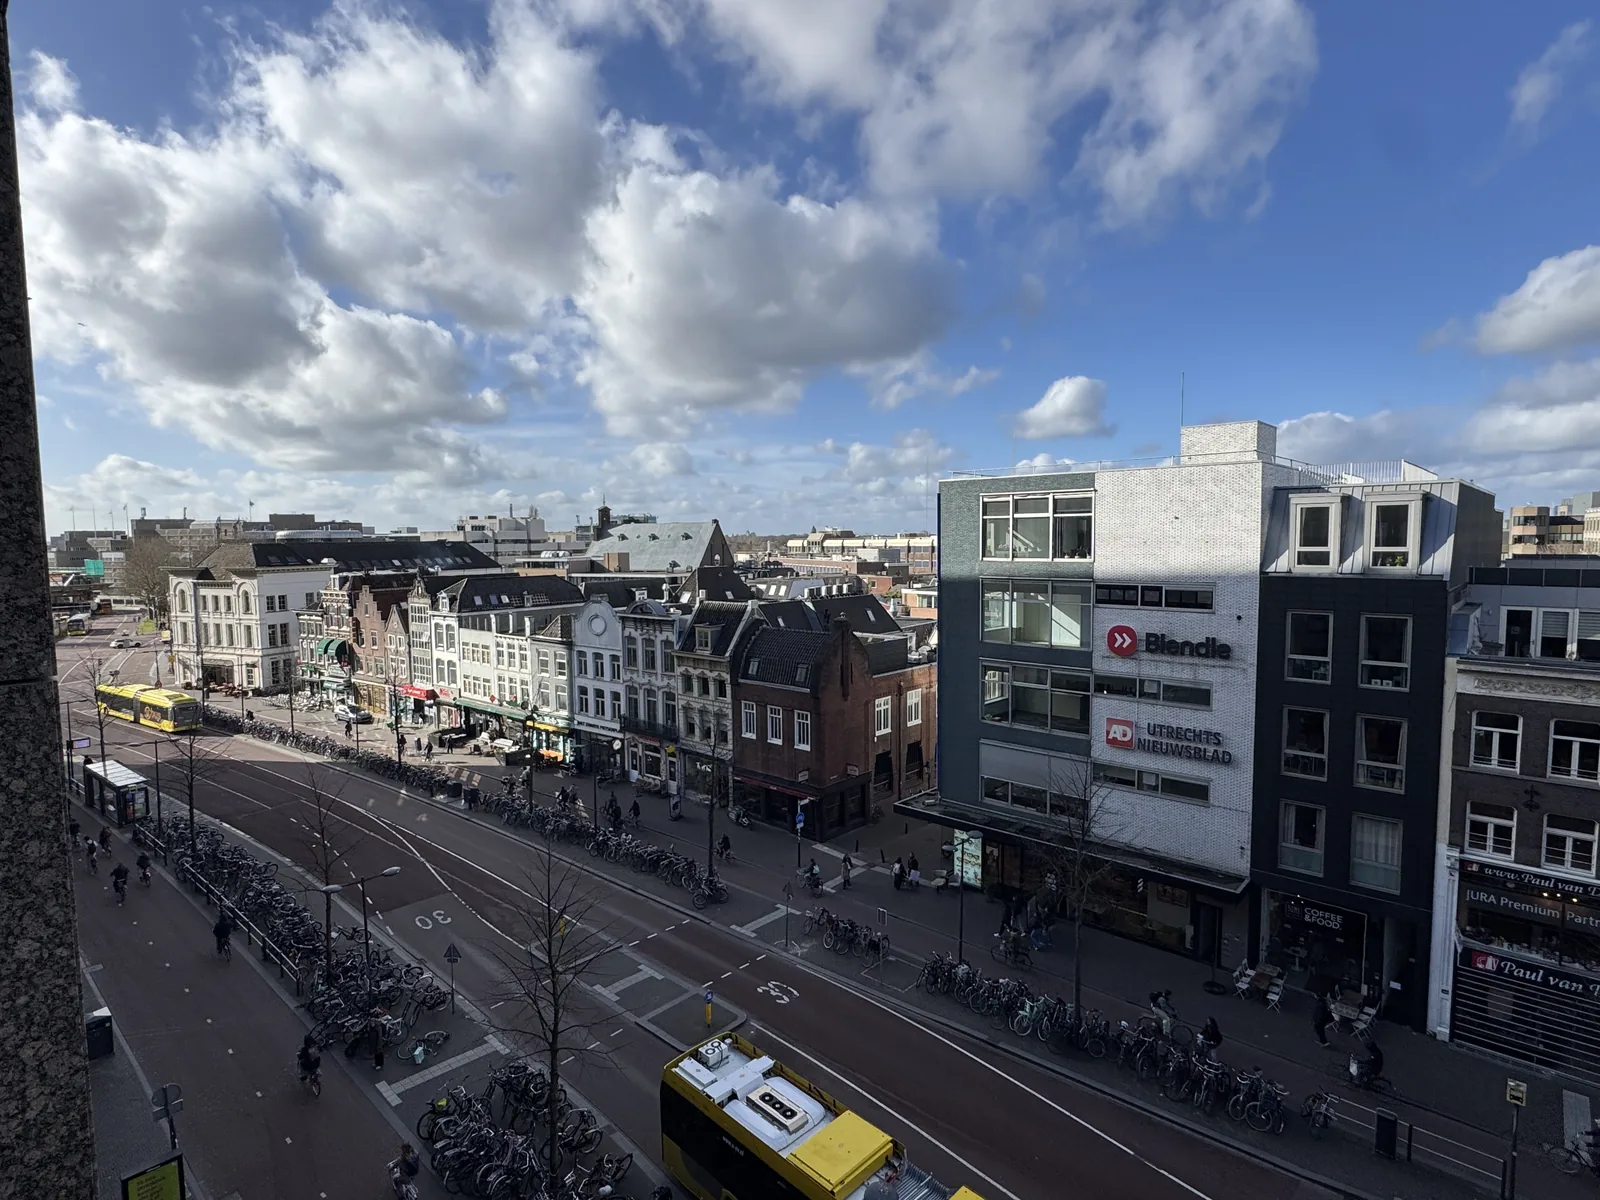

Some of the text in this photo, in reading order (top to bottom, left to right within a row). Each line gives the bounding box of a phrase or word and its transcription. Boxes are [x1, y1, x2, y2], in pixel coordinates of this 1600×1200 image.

[1145, 632, 1232, 660] Blendle
[1107, 724, 1132, 742] AD
[1147, 722, 1222, 745] UTRECHTS
[1137, 737, 1232, 764] NIEUWSBLAD
[1558, 882, 1584, 893] van
[1304, 907, 1344, 924] COFFEE
[1466, 889, 1497, 905] JURA
[1501, 896, 1560, 919] Premium
[415, 910, 452, 930] 30
[1501, 960, 1544, 982] Paul
[1548, 975, 1584, 993] van
